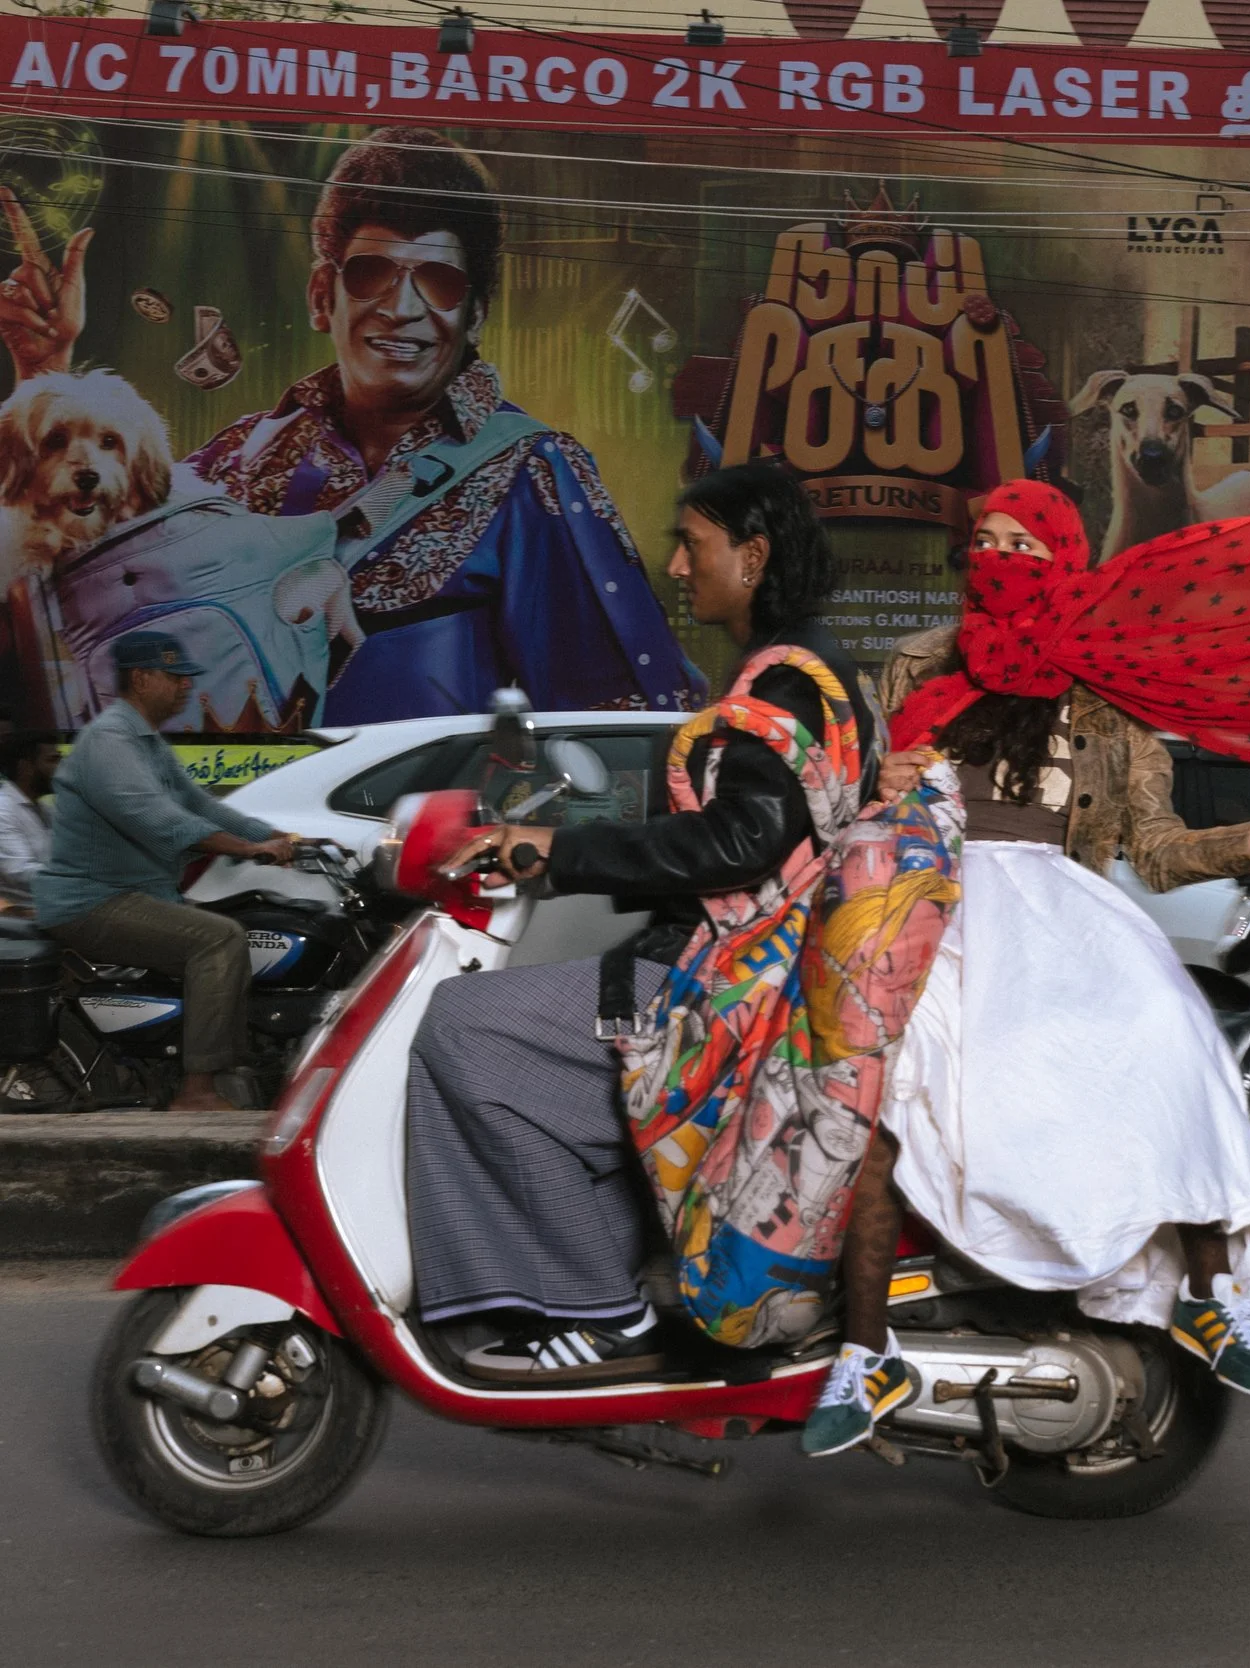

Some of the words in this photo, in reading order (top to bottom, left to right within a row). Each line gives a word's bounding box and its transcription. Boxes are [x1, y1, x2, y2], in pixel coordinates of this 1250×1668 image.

[11, 41, 128, 91] A/C
[652, 58, 746, 109] 2K
[778, 61, 925, 113] RGB
[957, 67, 1191, 120] LASER
[1128, 216, 1224, 244] LYCA
[1127, 245, 1224, 255] PRODUCTIONS
[807, 484, 943, 515] RETURNS
[834, 558, 904, 575] URAAJ
[831, 589, 921, 604] SANTHOSH
[814, 615, 872, 627] UCTIONS
[842, 639, 859, 650] BY
[862, 636, 895, 650] SUB
[247, 931, 283, 941] ERO
[248, 940, 289, 950] NDA
